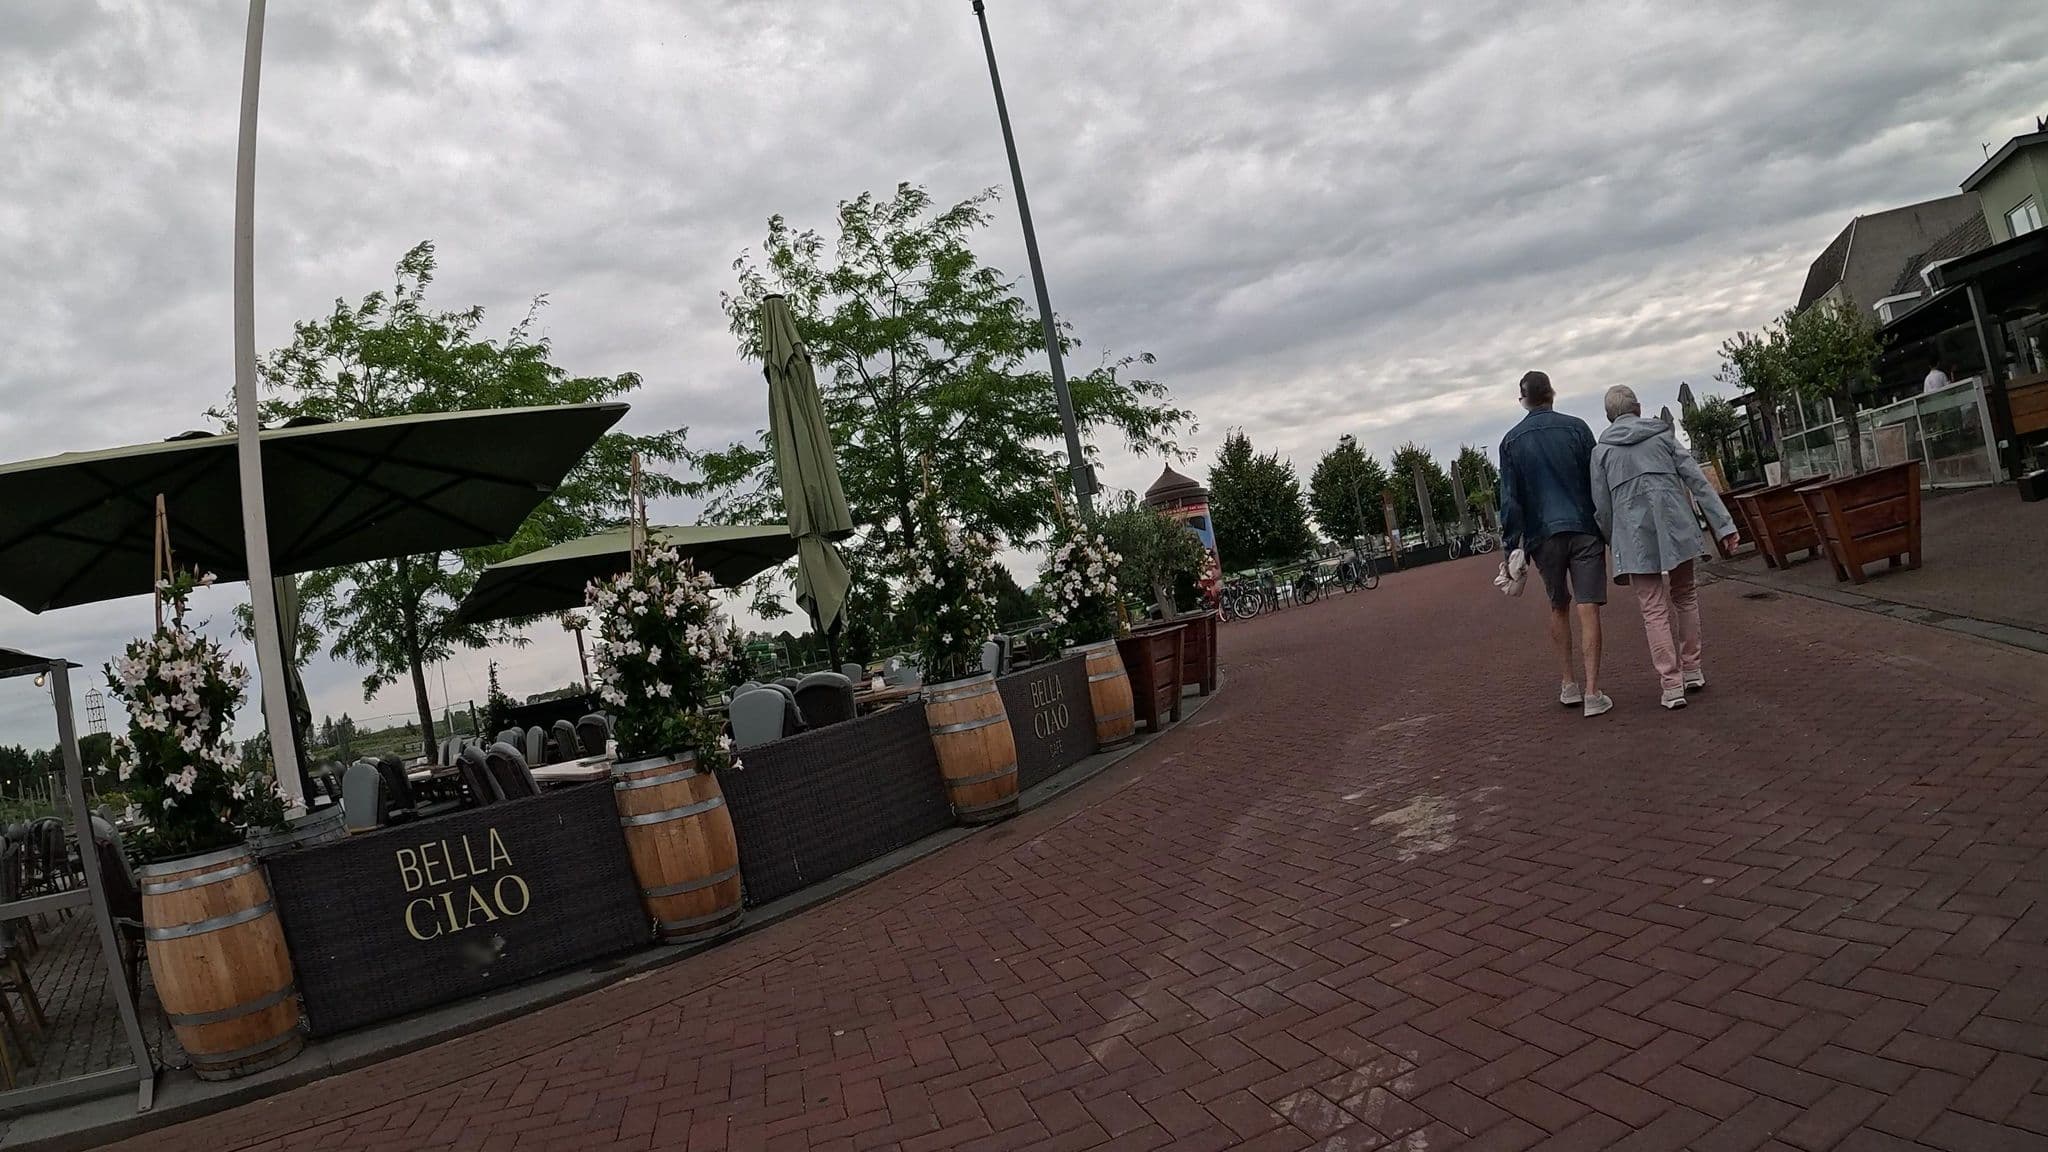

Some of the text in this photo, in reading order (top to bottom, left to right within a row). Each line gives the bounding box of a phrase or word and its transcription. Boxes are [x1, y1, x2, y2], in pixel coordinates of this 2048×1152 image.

[1030, 674, 1064, 708] BELLA
[1034, 703, 1069, 739] CIAO
[396, 828, 513, 892] BELLA
[405, 874, 530, 940] CIAO
